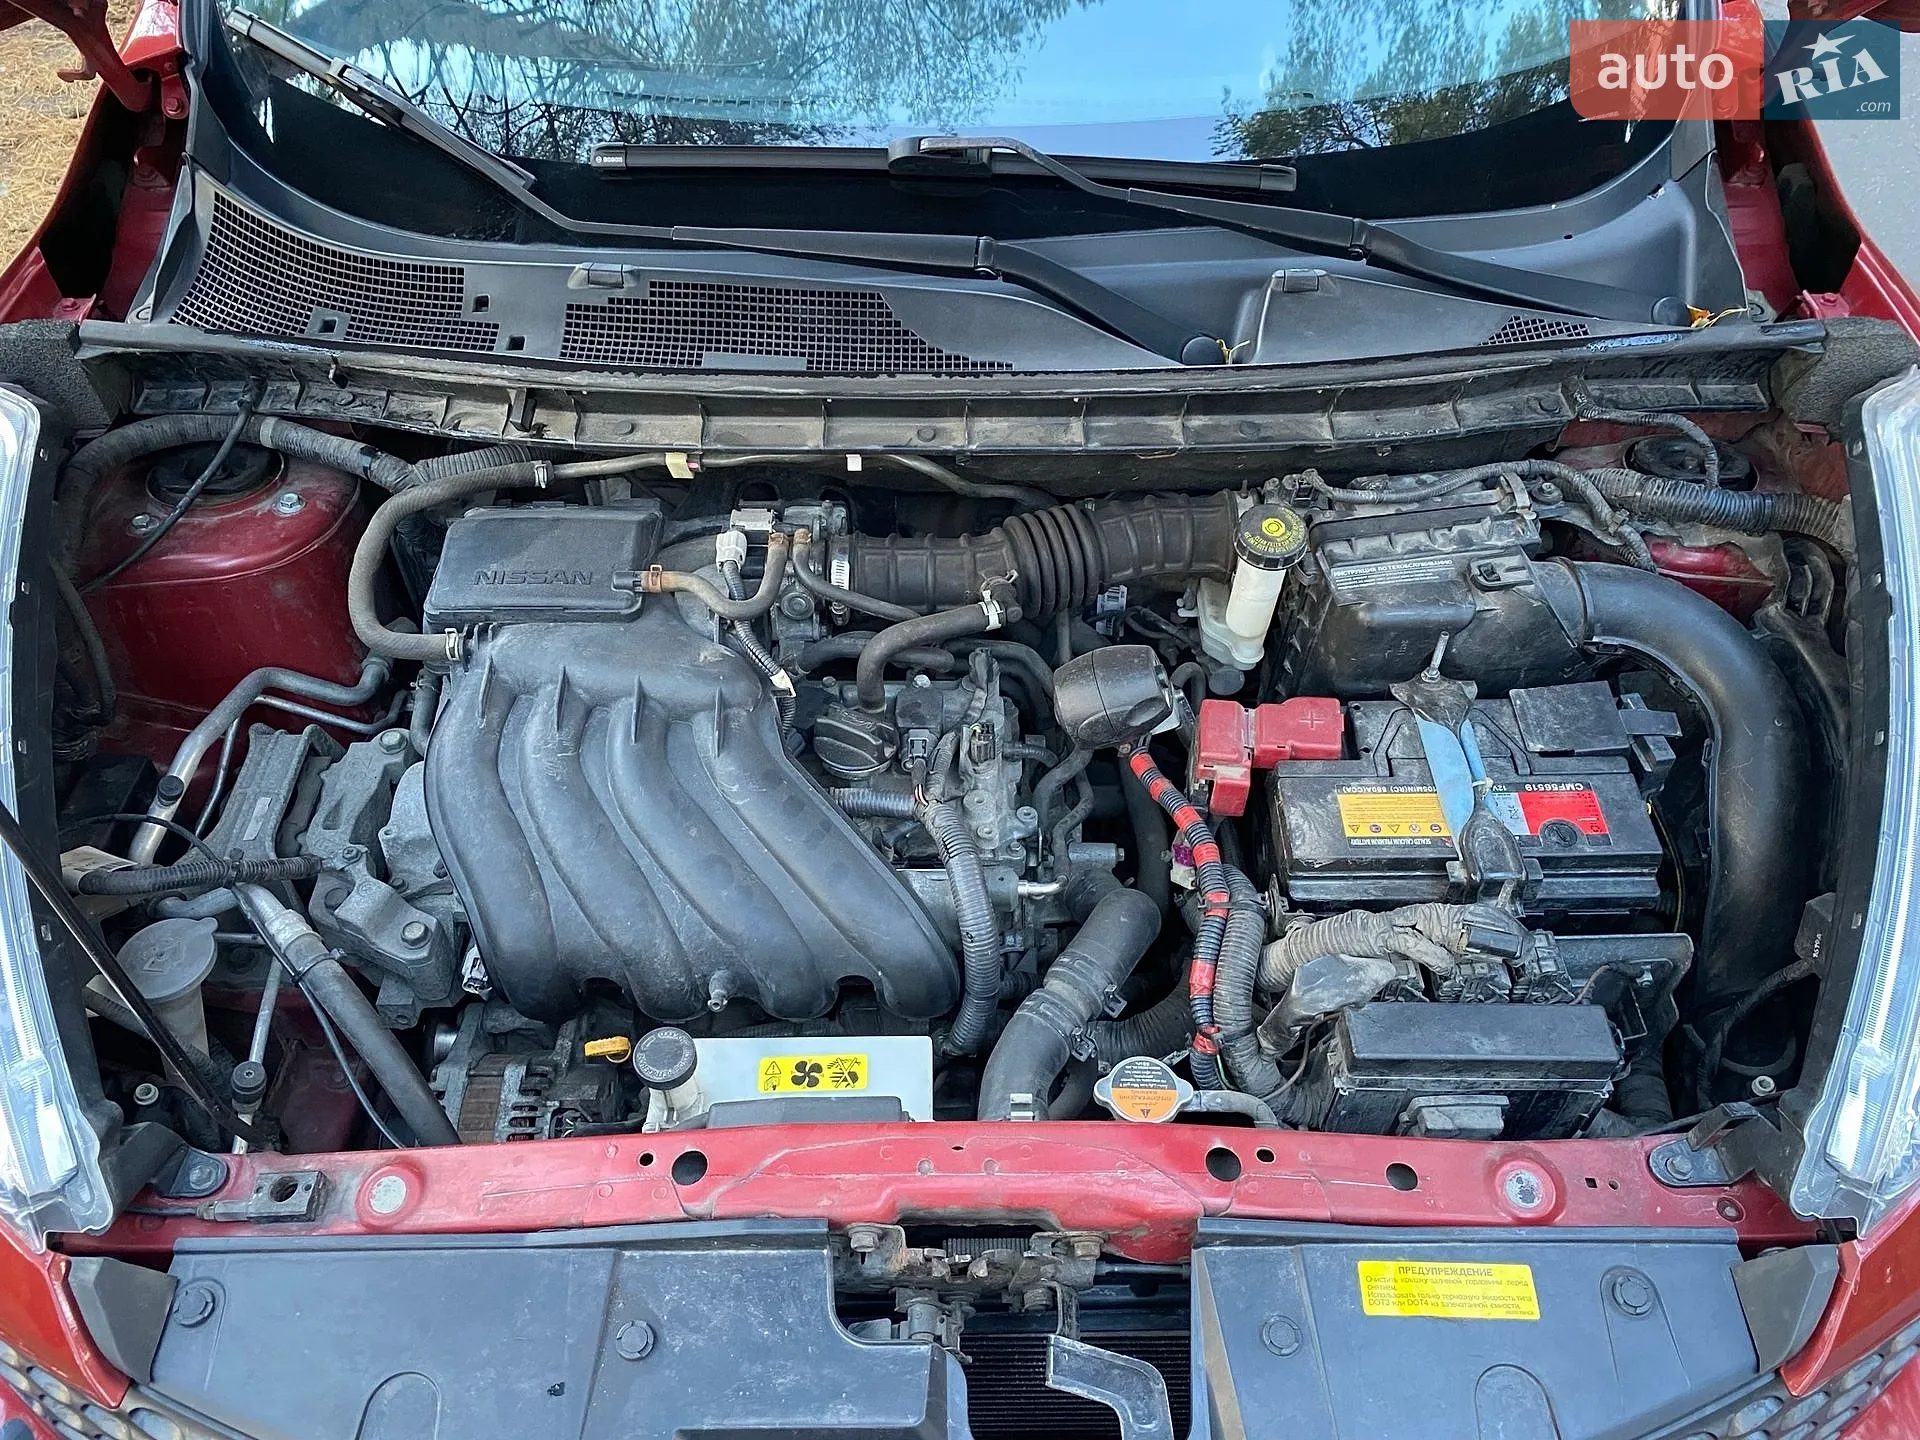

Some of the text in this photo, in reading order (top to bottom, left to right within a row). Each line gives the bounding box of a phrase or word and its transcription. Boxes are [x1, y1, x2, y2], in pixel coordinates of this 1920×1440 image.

[473, 571, 593, 585] NISSAN
[1524, 783, 1584, 792] CMF56519
[1398, 1266, 1493, 1277] ПРЕДУПРЕЖДЕНИЕ
[1365, 1275, 1399, 1284] Очистить
[1400, 1277, 1429, 1285] крышку
[1367, 1290, 1416, 1299] Использовать
